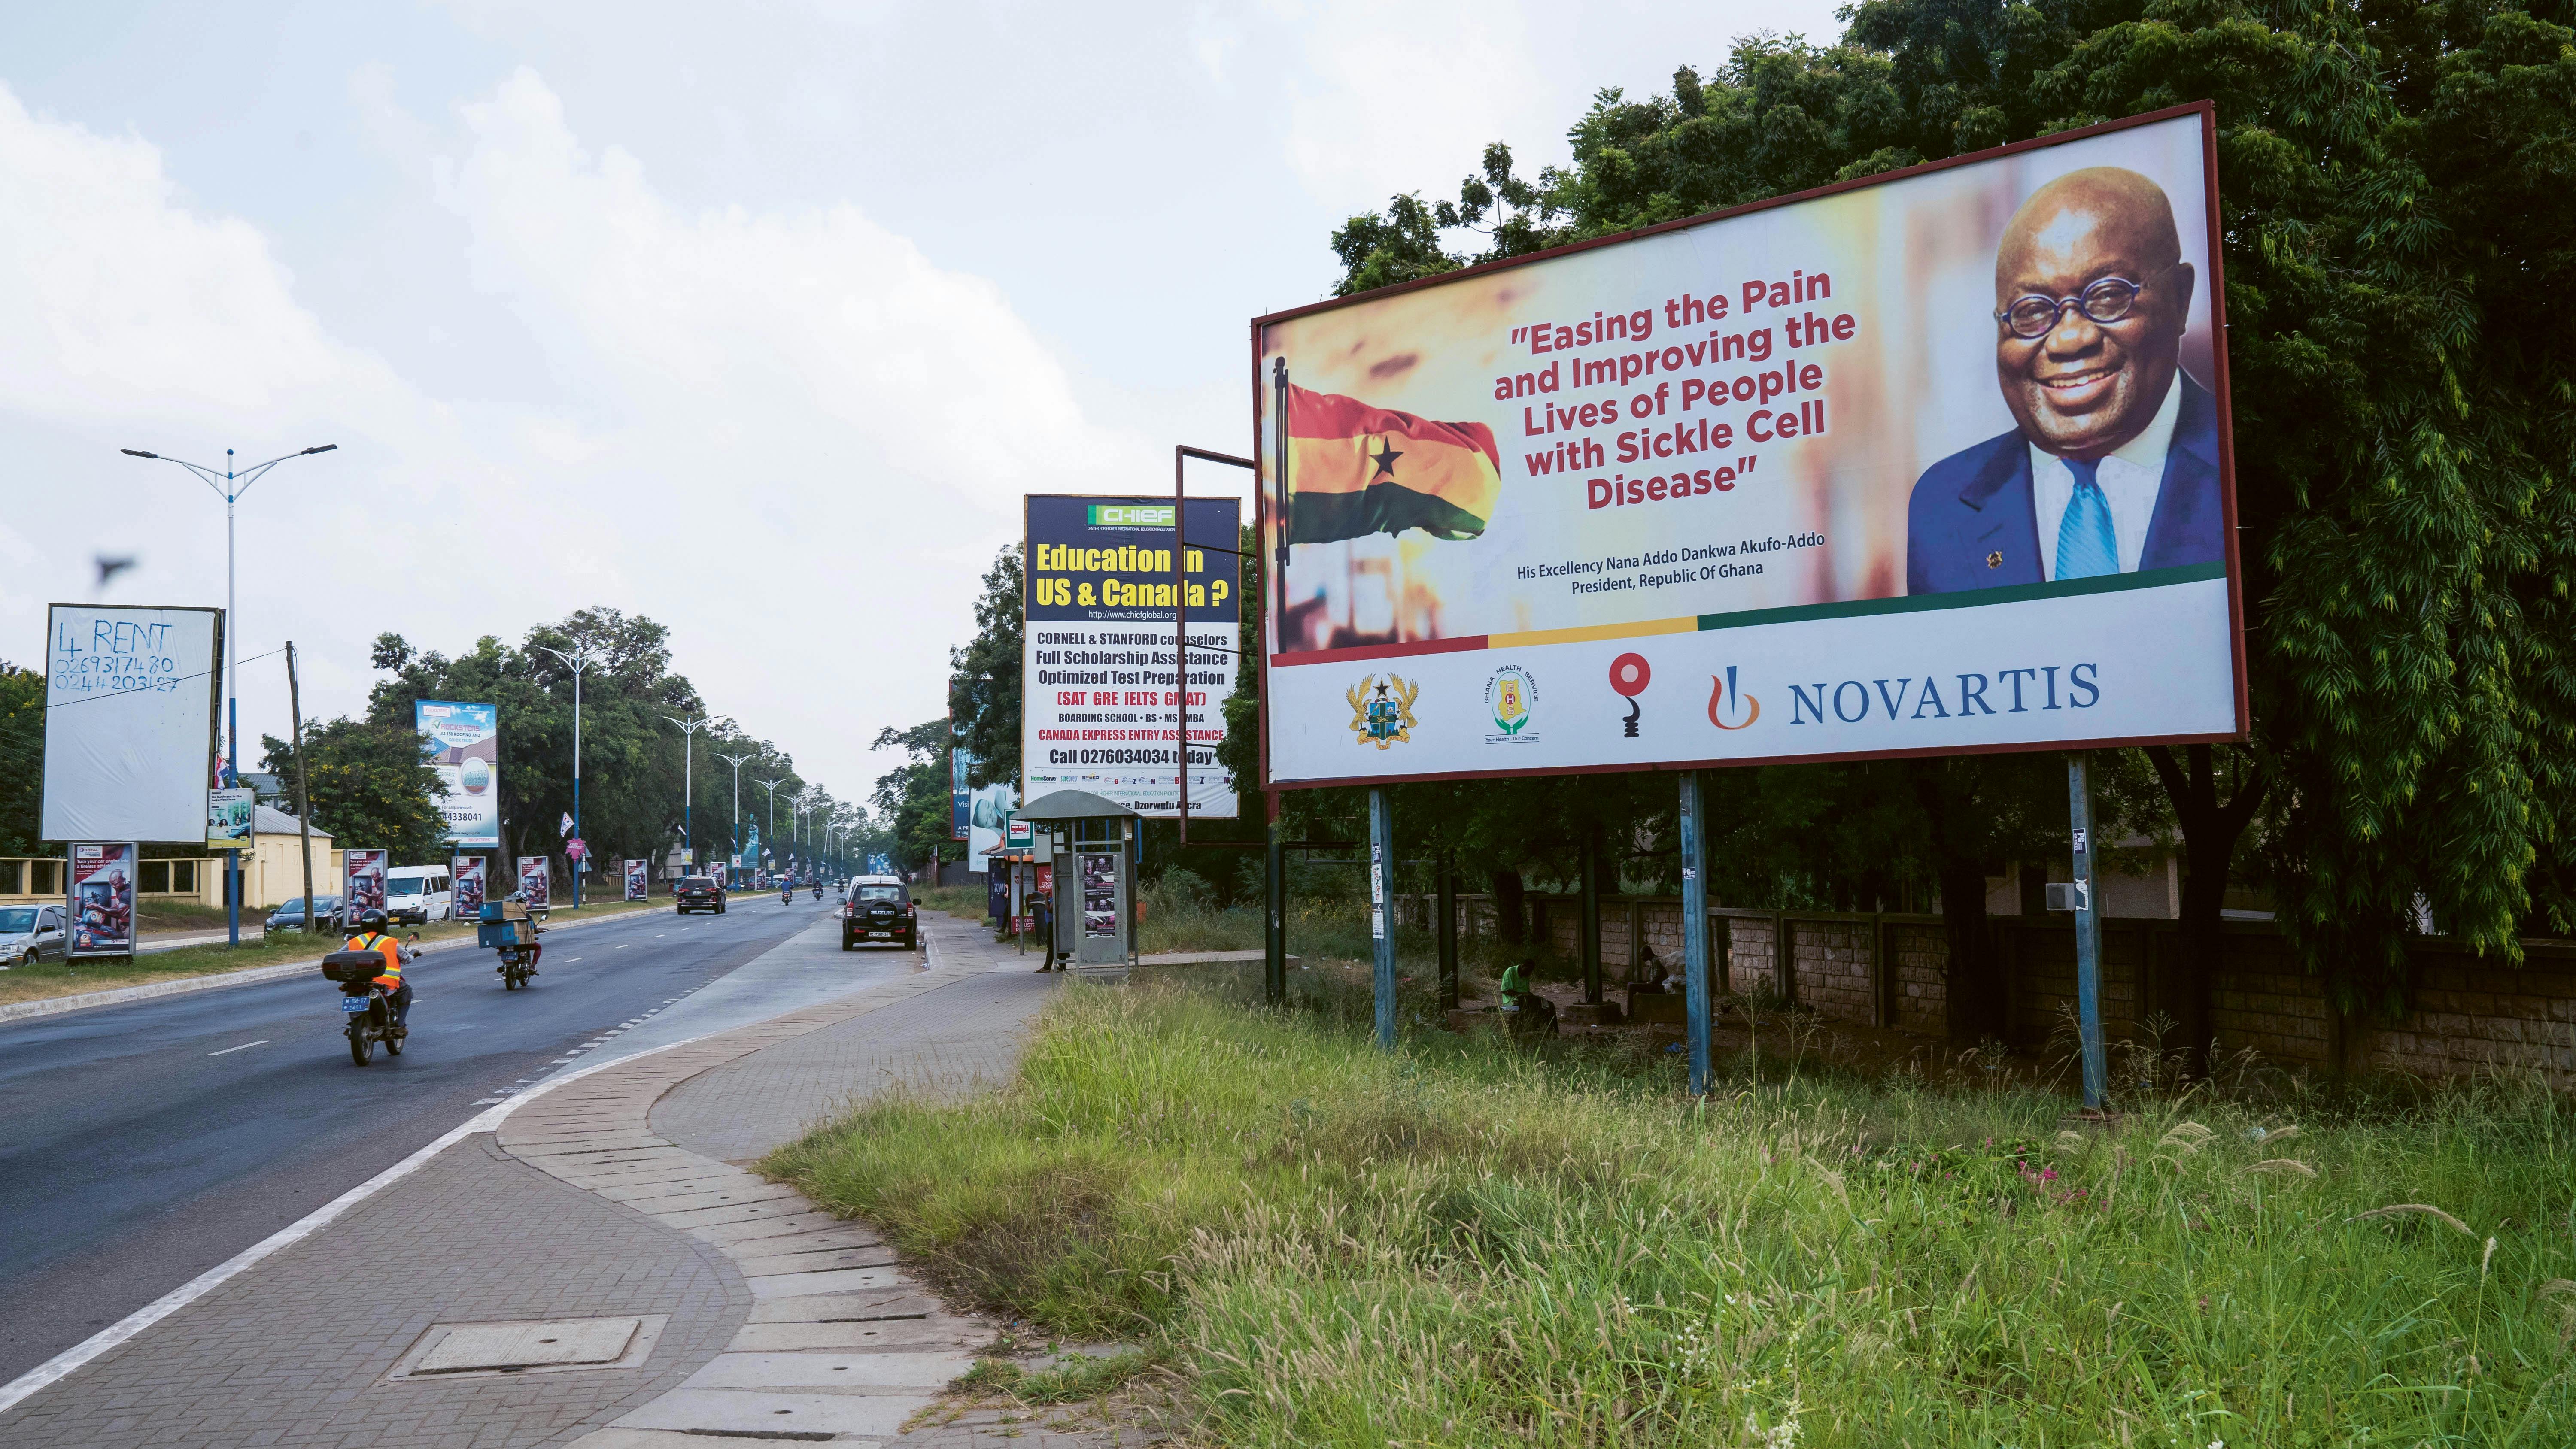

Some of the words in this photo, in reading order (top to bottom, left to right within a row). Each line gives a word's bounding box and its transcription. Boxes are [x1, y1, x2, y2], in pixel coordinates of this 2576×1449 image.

[1512, 310, 1652, 354] "Easing
[1665, 294, 1728, 328] the
[1743, 270, 1830, 313] Pain
[1495, 361, 1559, 400] and
[1573, 328, 1771, 387] Improving
[1786, 312, 1855, 348] the
[1525, 401, 1617, 436] Lives
[1631, 382, 1668, 418] of
[1683, 360, 1822, 410] People
[1525, 438, 1604, 476] with
[1617, 419, 1732, 462] Sickle
[1747, 400, 1824, 442] Cell
[1588, 455, 1756, 509] Disease"
[1104, 509, 1172, 522] CHIEF
[1037, 543, 1171, 572] Education
[1183, 545, 1203, 572] n
[1518, 566, 1536, 579] His
[1539, 561, 1603, 577] Excellency
[1607, 557, 1639, 570] Nana
[1643, 549, 1678, 566] Addo
[1682, 544, 1736, 561] Dankwa
[1740, 532, 1825, 555] Akufo-Addo
[1036, 578, 1071, 606] US
[1077, 582, 1097, 606] &
[1212, 580, 1228, 607] ?
[1572, 577, 1636, 594] President,
[1639, 569, 1697, 589] Republic
[1700, 565, 1716, 580] Of
[1719, 563, 1764, 578] Ghana
[1088, 610, 1177, 621] http://www.chiefglobal.org
[59, 622, 83, 658] 4
[94, 619, 173, 653] RENT
[1037, 632, 1086, 645] CORNELL
[1088, 634, 1097, 644] &
[1099, 633, 1157, 645] STANFORD
[1036, 650, 1060, 664] Full
[1064, 650, 1148, 666] Scholarship
[1039, 670, 1108, 685] Optimized
[1111, 671, 1140, 685] Test
[1484, 677, 1495, 704] GHANA
[1496, 664, 1522, 675] HEALTH
[1524, 671, 1538, 702] SERVICE
[1057, 691, 1087, 706] (SAT
[1093, 692, 1118, 706] GRE
[1124, 692, 1158, 706] IELTS
[1788, 663, 2100, 725] NOVARTIS
[1059, 713, 1103, 723] BOARDING
[1104, 713, 1138, 723] SCHOOL
[1145, 713, 1157, 723] BS
[1164, 714, 1178, 723] MS
[1185, 714, 1204, 723] MBA
[1039, 729, 1080, 740] CANADA
[1082, 729, 1126, 740] EXPRESS
[1128, 730, 1159, 740] ENTRY
[1162, 730, 1224, 741] ASSSTANCE
[1050, 749, 1077, 764] Call
[1081, 749, 1170, 764] 0276034034
[1173, 749, 1212, 765] tday
[1134, 801, 1174, 810] Dzorwulu
[1176, 801, 1201, 810] Acra
[994, 883, 1005, 893] KWI
